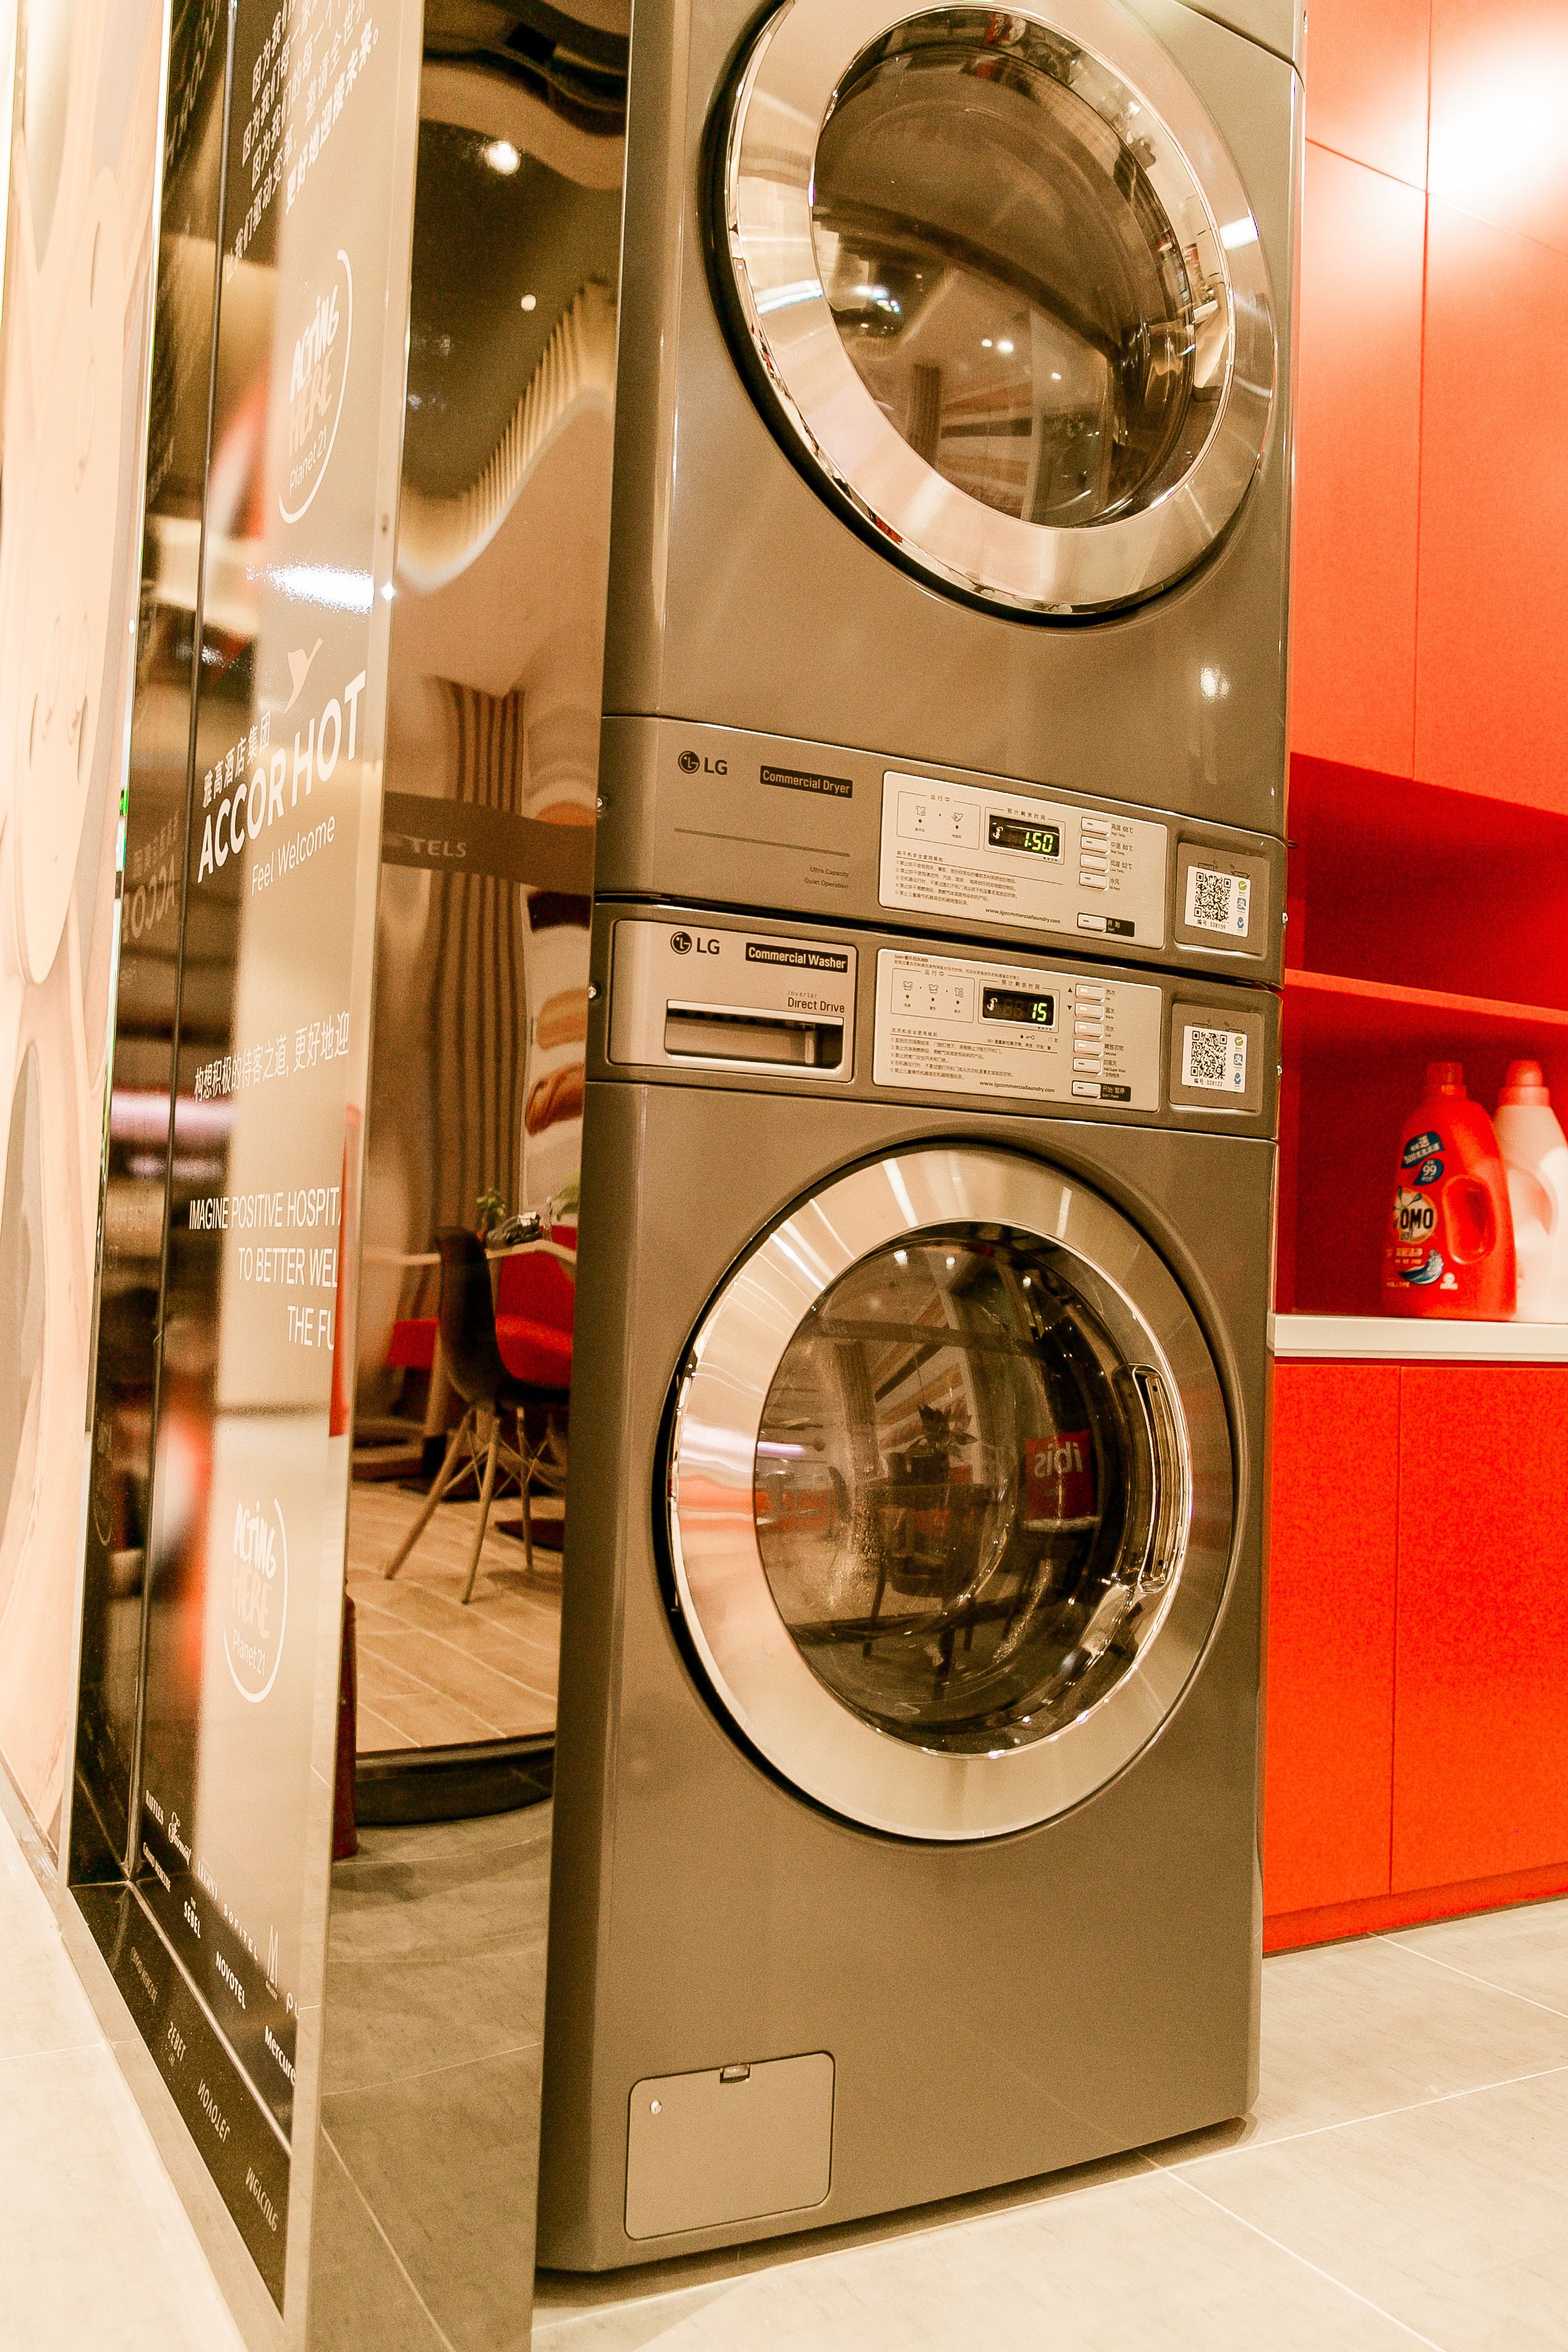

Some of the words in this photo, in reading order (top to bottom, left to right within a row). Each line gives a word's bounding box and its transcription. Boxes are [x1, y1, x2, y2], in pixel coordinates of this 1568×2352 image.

[289, 443, 318, 498] Planet
[318, 424, 327, 453] 21
[202, 710, 271, 809] 雅高酒店集团
[704, 757, 728, 776] LG
[763, 769, 821, 790] Commercial
[823, 781, 850, 795] Dryer
[251, 864, 274, 896] Feel
[278, 815, 337, 878] Welcome
[821, 880, 849, 889] Operation
[825, 869, 849, 878] Capacity
[985, 908, 1061, 924] www.lgcommerciallaundry.com
[697, 938, 720, 955] LG
[748, 947, 806, 965] Commercial
[808, 955, 847, 969] Washer
[788, 997, 817, 1011] Direct
[820, 1001, 845, 1013] Drive
[1032, 1002, 1048, 1021] 15
[979, 1081, 1055, 1093] www.lgcommerciallaundry.com
[189, 1196, 228, 1230] IMAGINE
[231, 1191, 283, 1228] POSITIVE
[1400, 1208, 1434, 1229] OMO
[238, 1247, 252, 1281] TO
[255, 1247, 305, 1285] BETTER
[287, 1305, 314, 1346] THE
[168, 1811, 192, 1866] Fairmont
[184, 1901, 200, 1939] SEBEL
[223, 1903, 259, 1961] SOFITEL
[216, 1951, 246, 2010] NOVOTEL
[265, 2025, 296, 2087] Mercure
